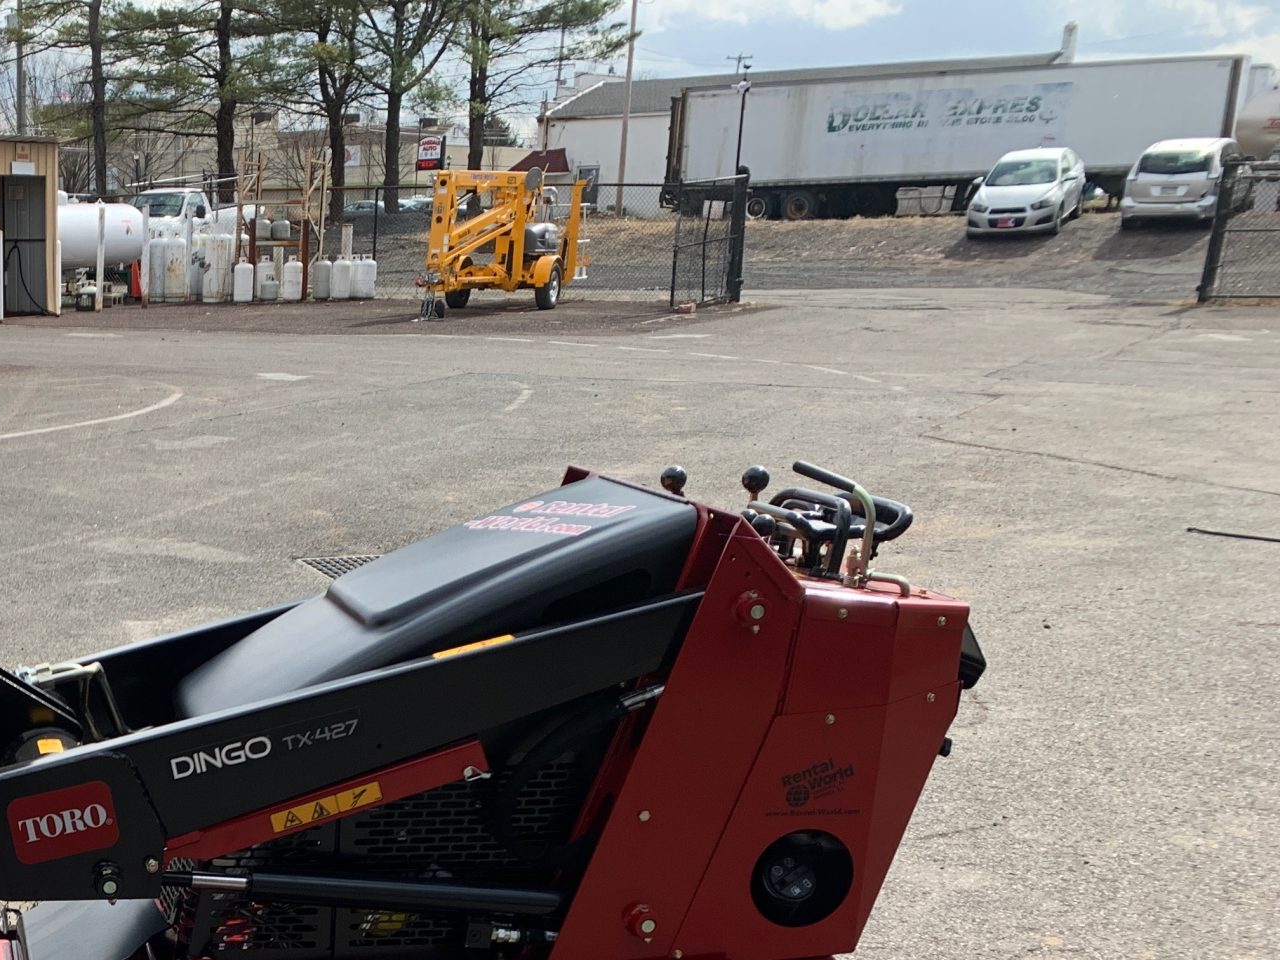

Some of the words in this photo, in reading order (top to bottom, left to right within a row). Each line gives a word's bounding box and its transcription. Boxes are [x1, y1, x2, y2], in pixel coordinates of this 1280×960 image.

[169, 735, 273, 780] DINGO
[781, 757, 835, 788] Rental
[808, 763, 855, 790] World
[18, 803, 108, 844] TORO
